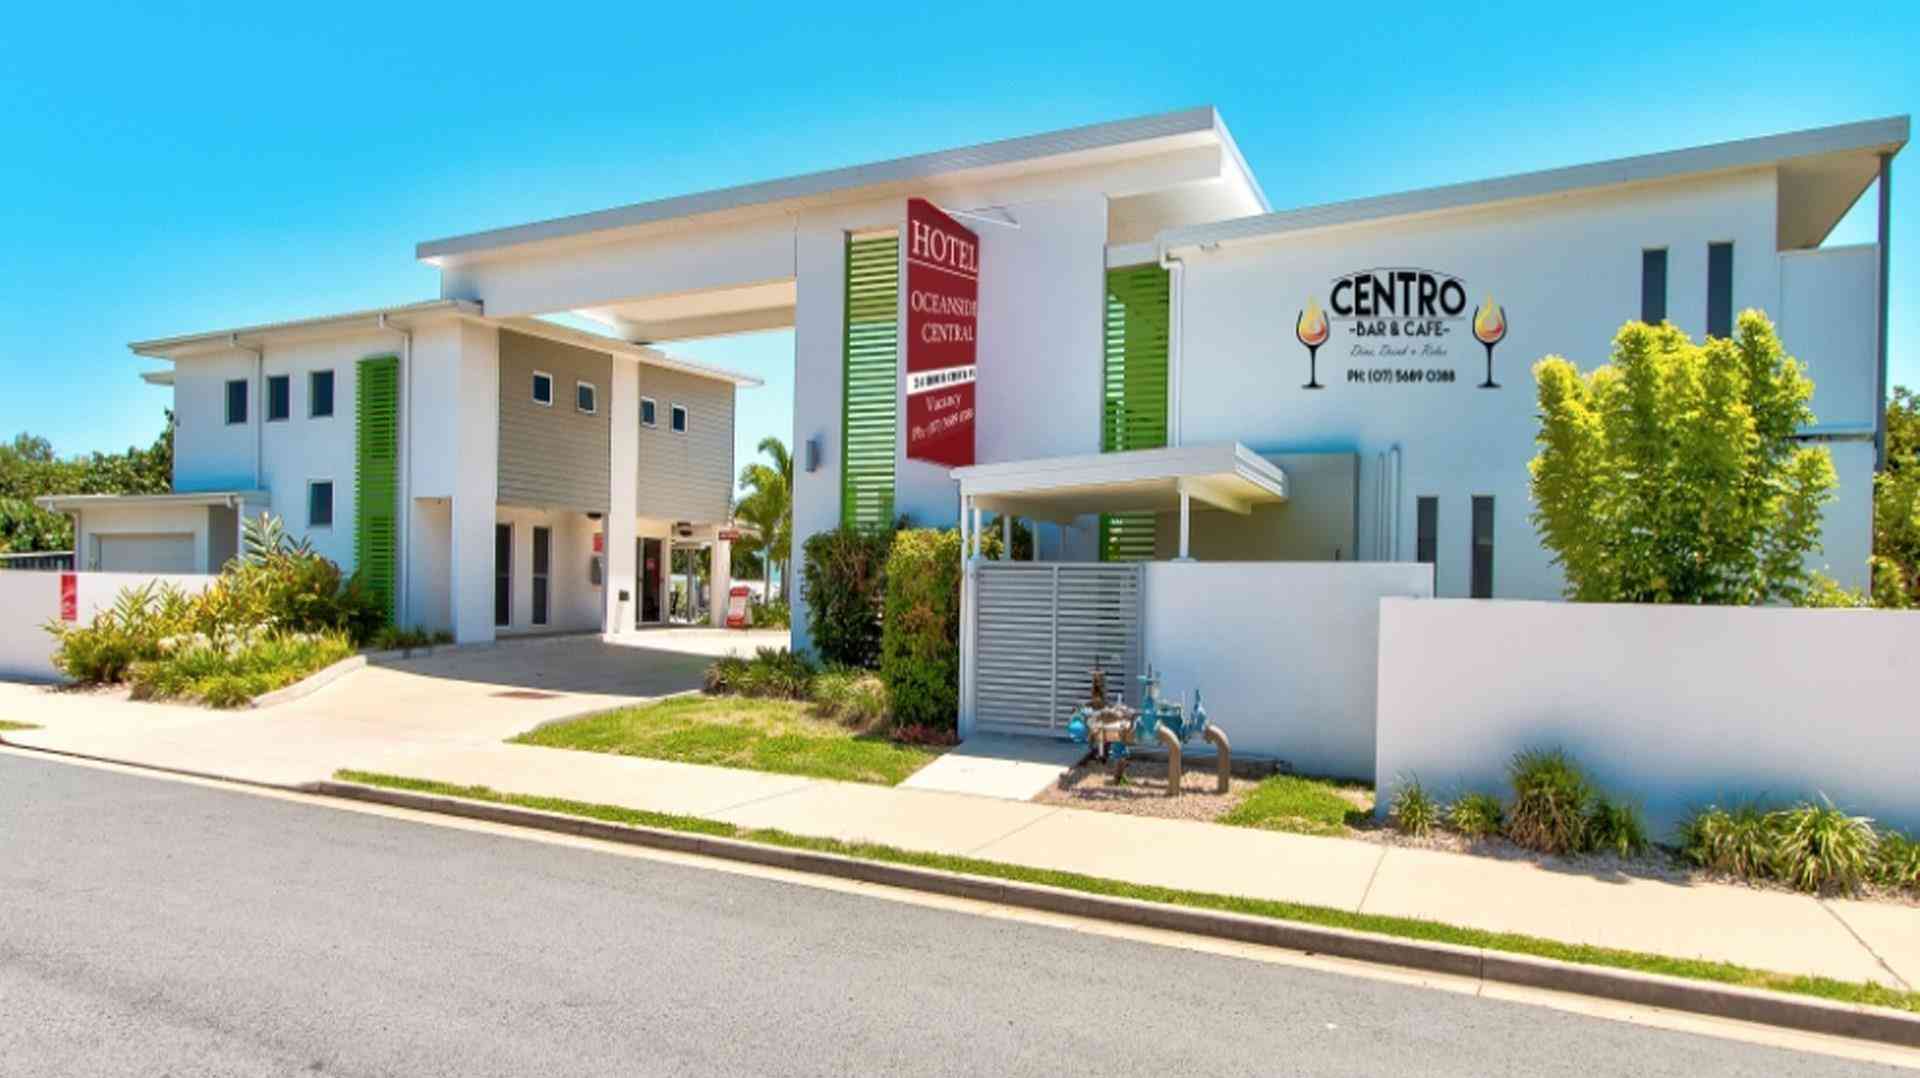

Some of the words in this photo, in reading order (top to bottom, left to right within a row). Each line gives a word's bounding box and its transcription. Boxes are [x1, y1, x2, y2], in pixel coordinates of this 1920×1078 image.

[912, 220, 977, 273] HOTEL
[1330, 272, 1466, 315] CENTRO
[921, 323, 974, 343] CENTRAL
[1390, 321, 1399, 336] &
[1368, 369, 1392, 384] (07)
